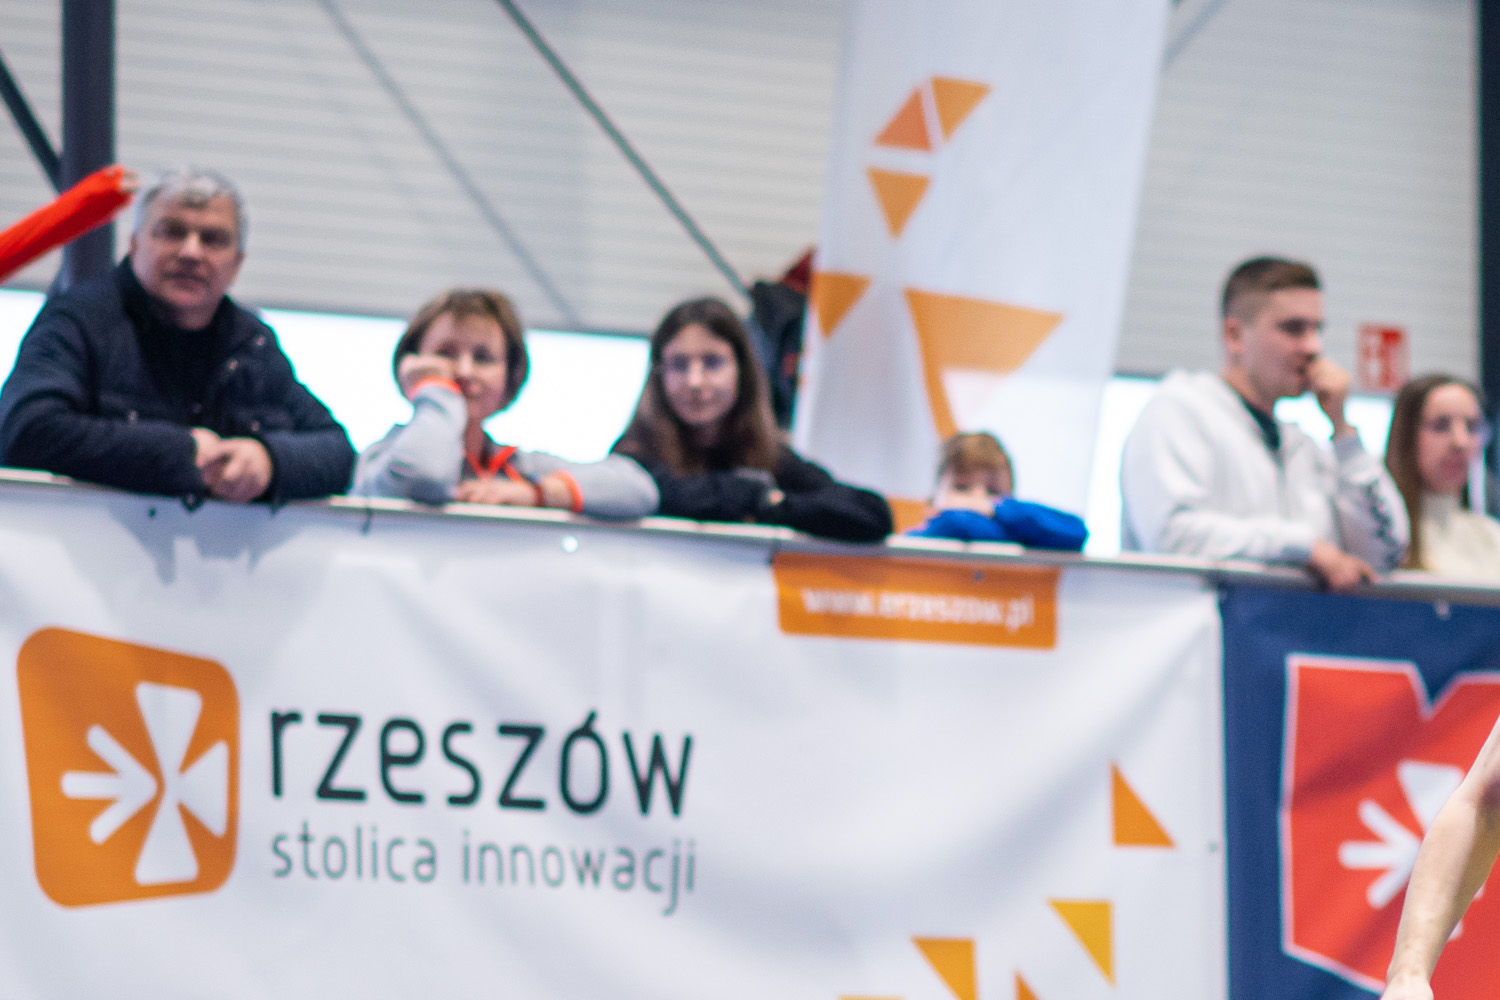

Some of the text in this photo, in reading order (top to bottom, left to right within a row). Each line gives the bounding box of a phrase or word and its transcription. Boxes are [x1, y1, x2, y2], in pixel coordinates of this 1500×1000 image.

[270, 709, 693, 817] rzeszów
[272, 820, 696, 915] stolica innowacji
